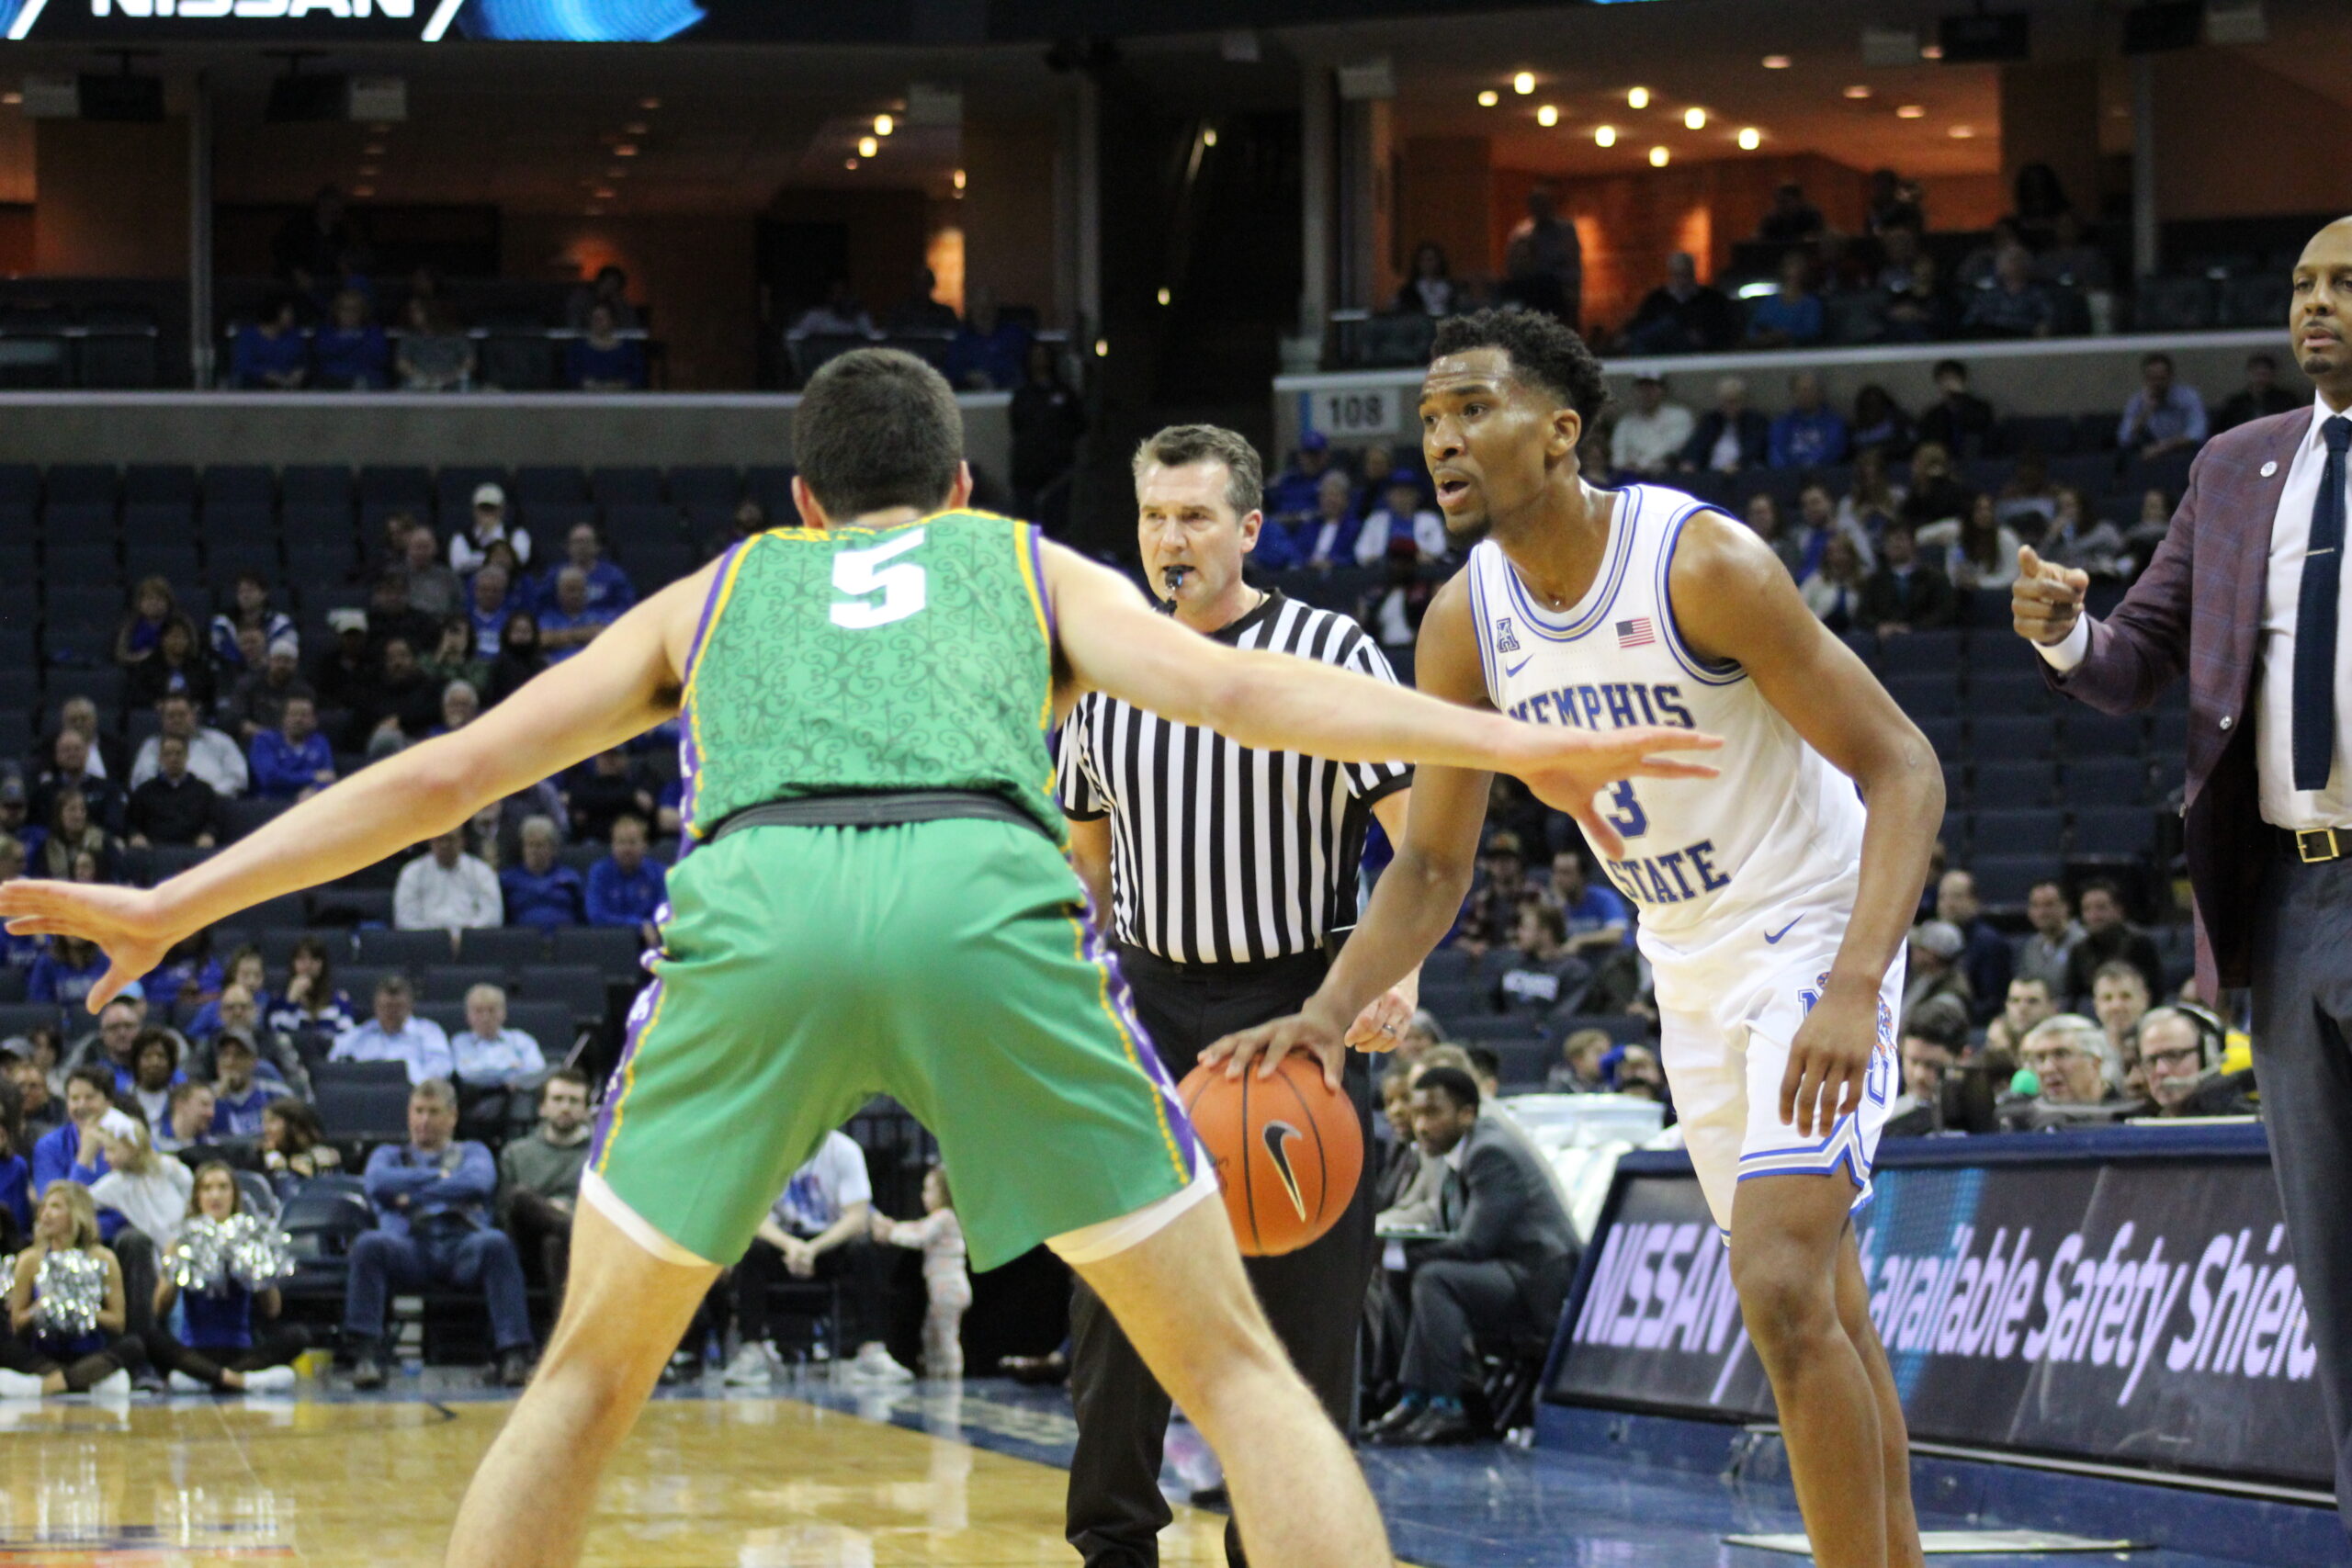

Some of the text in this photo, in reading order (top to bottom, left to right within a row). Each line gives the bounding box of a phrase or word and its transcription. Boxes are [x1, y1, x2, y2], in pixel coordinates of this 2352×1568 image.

[830, 526, 926, 630] 5
[1606, 778, 1650, 840] 3
[1607, 838, 1731, 903] STATE
[1572, 1223, 1739, 1354] NISSAN
[1870, 1223, 2041, 1361] available
[2022, 1220, 2189, 1408] Safety
